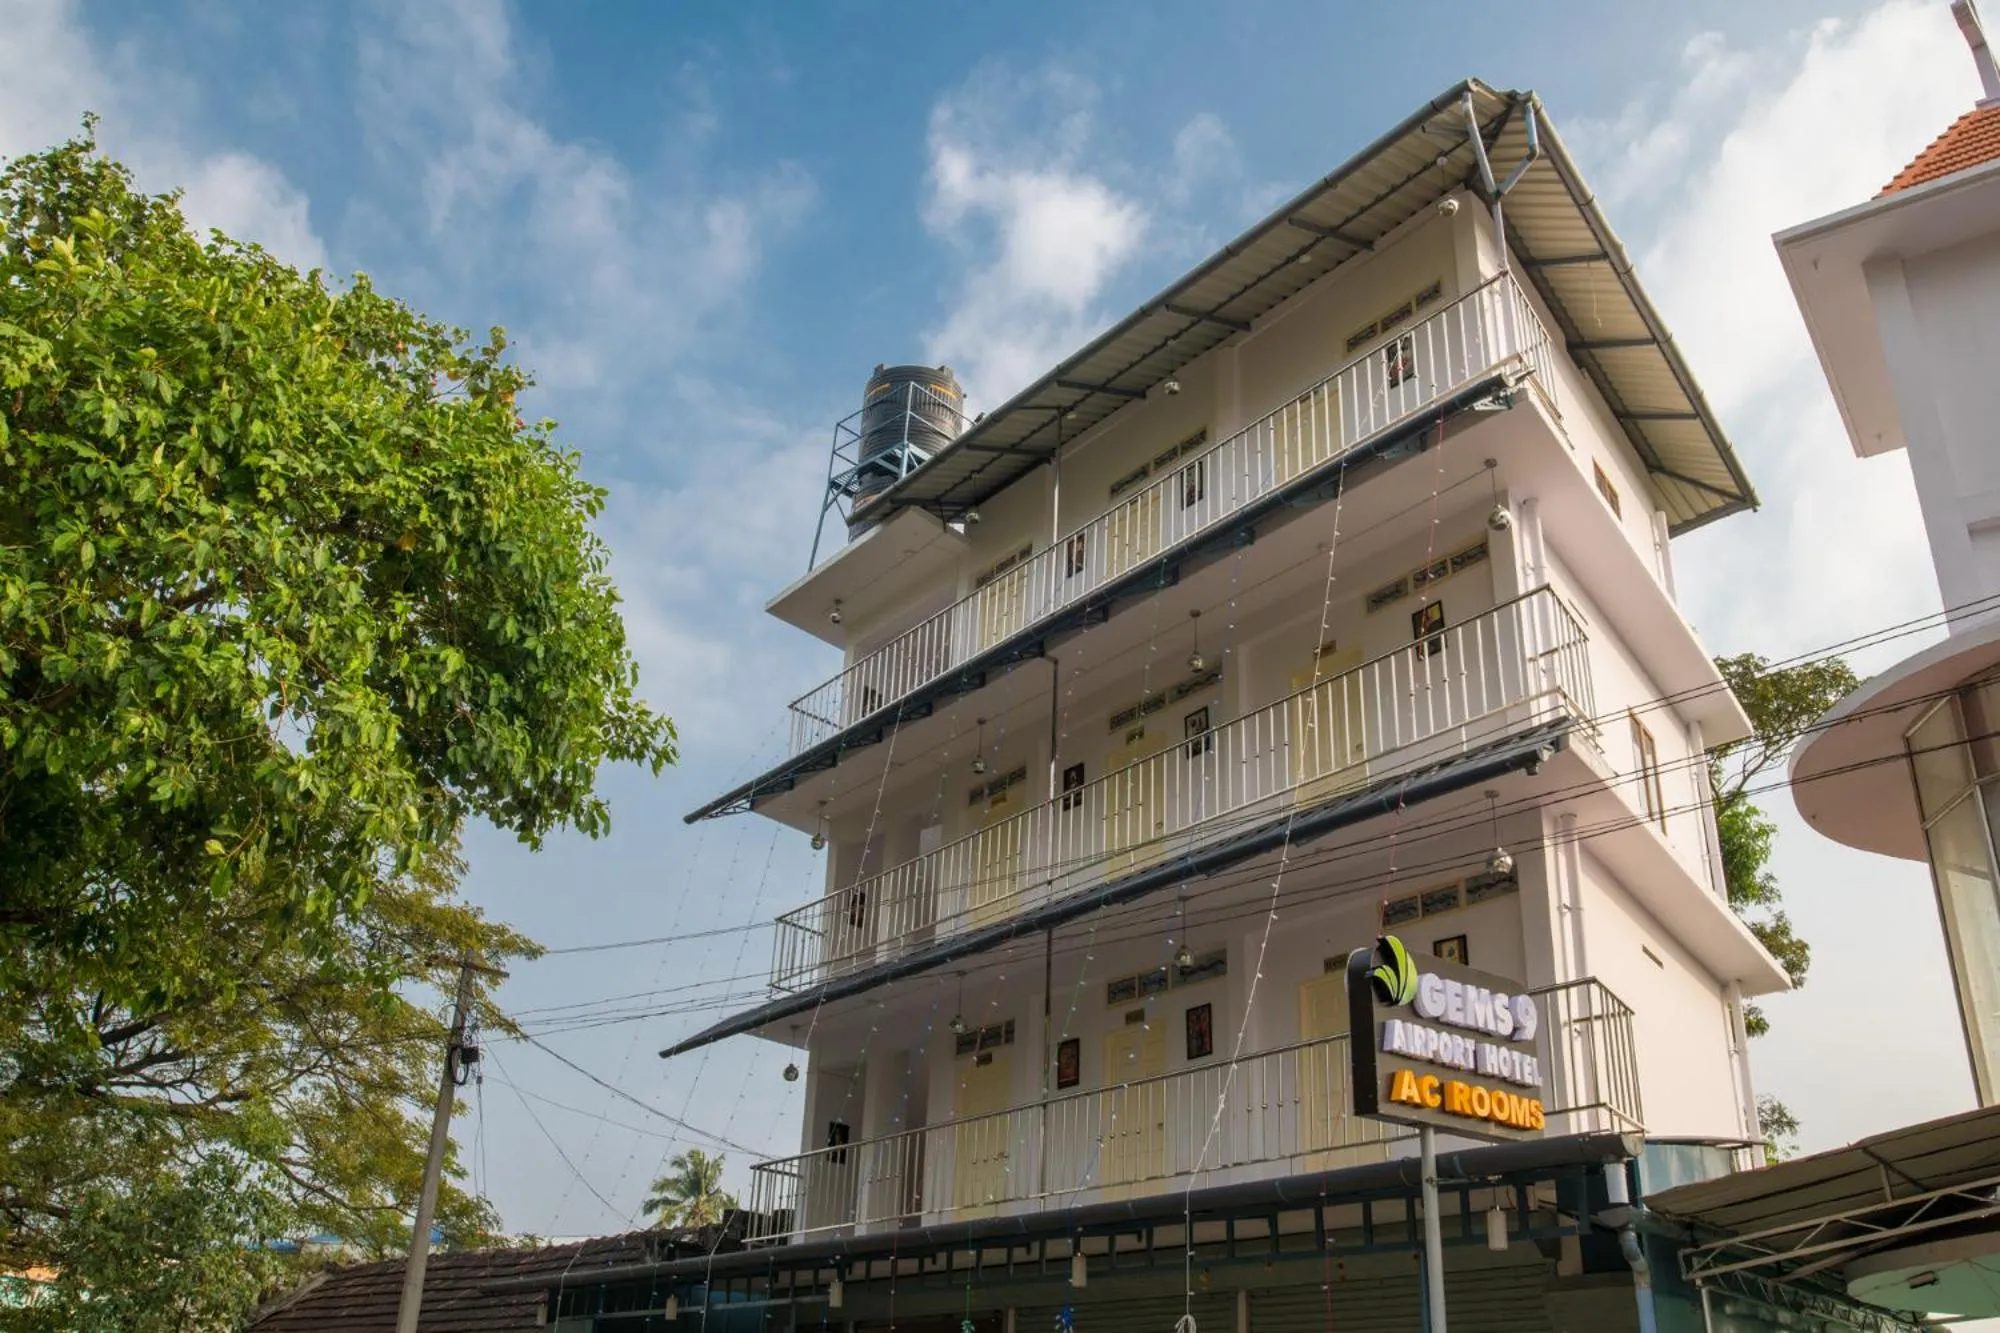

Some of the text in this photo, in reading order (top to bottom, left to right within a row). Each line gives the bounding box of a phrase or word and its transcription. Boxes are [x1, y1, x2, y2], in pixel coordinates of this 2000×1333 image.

[1413, 973, 1537, 1041] GEMS 9
[1384, 1019, 1542, 1087] AIRPORT HOTEL
[1391, 1069, 1544, 1129] AC ROOMS
